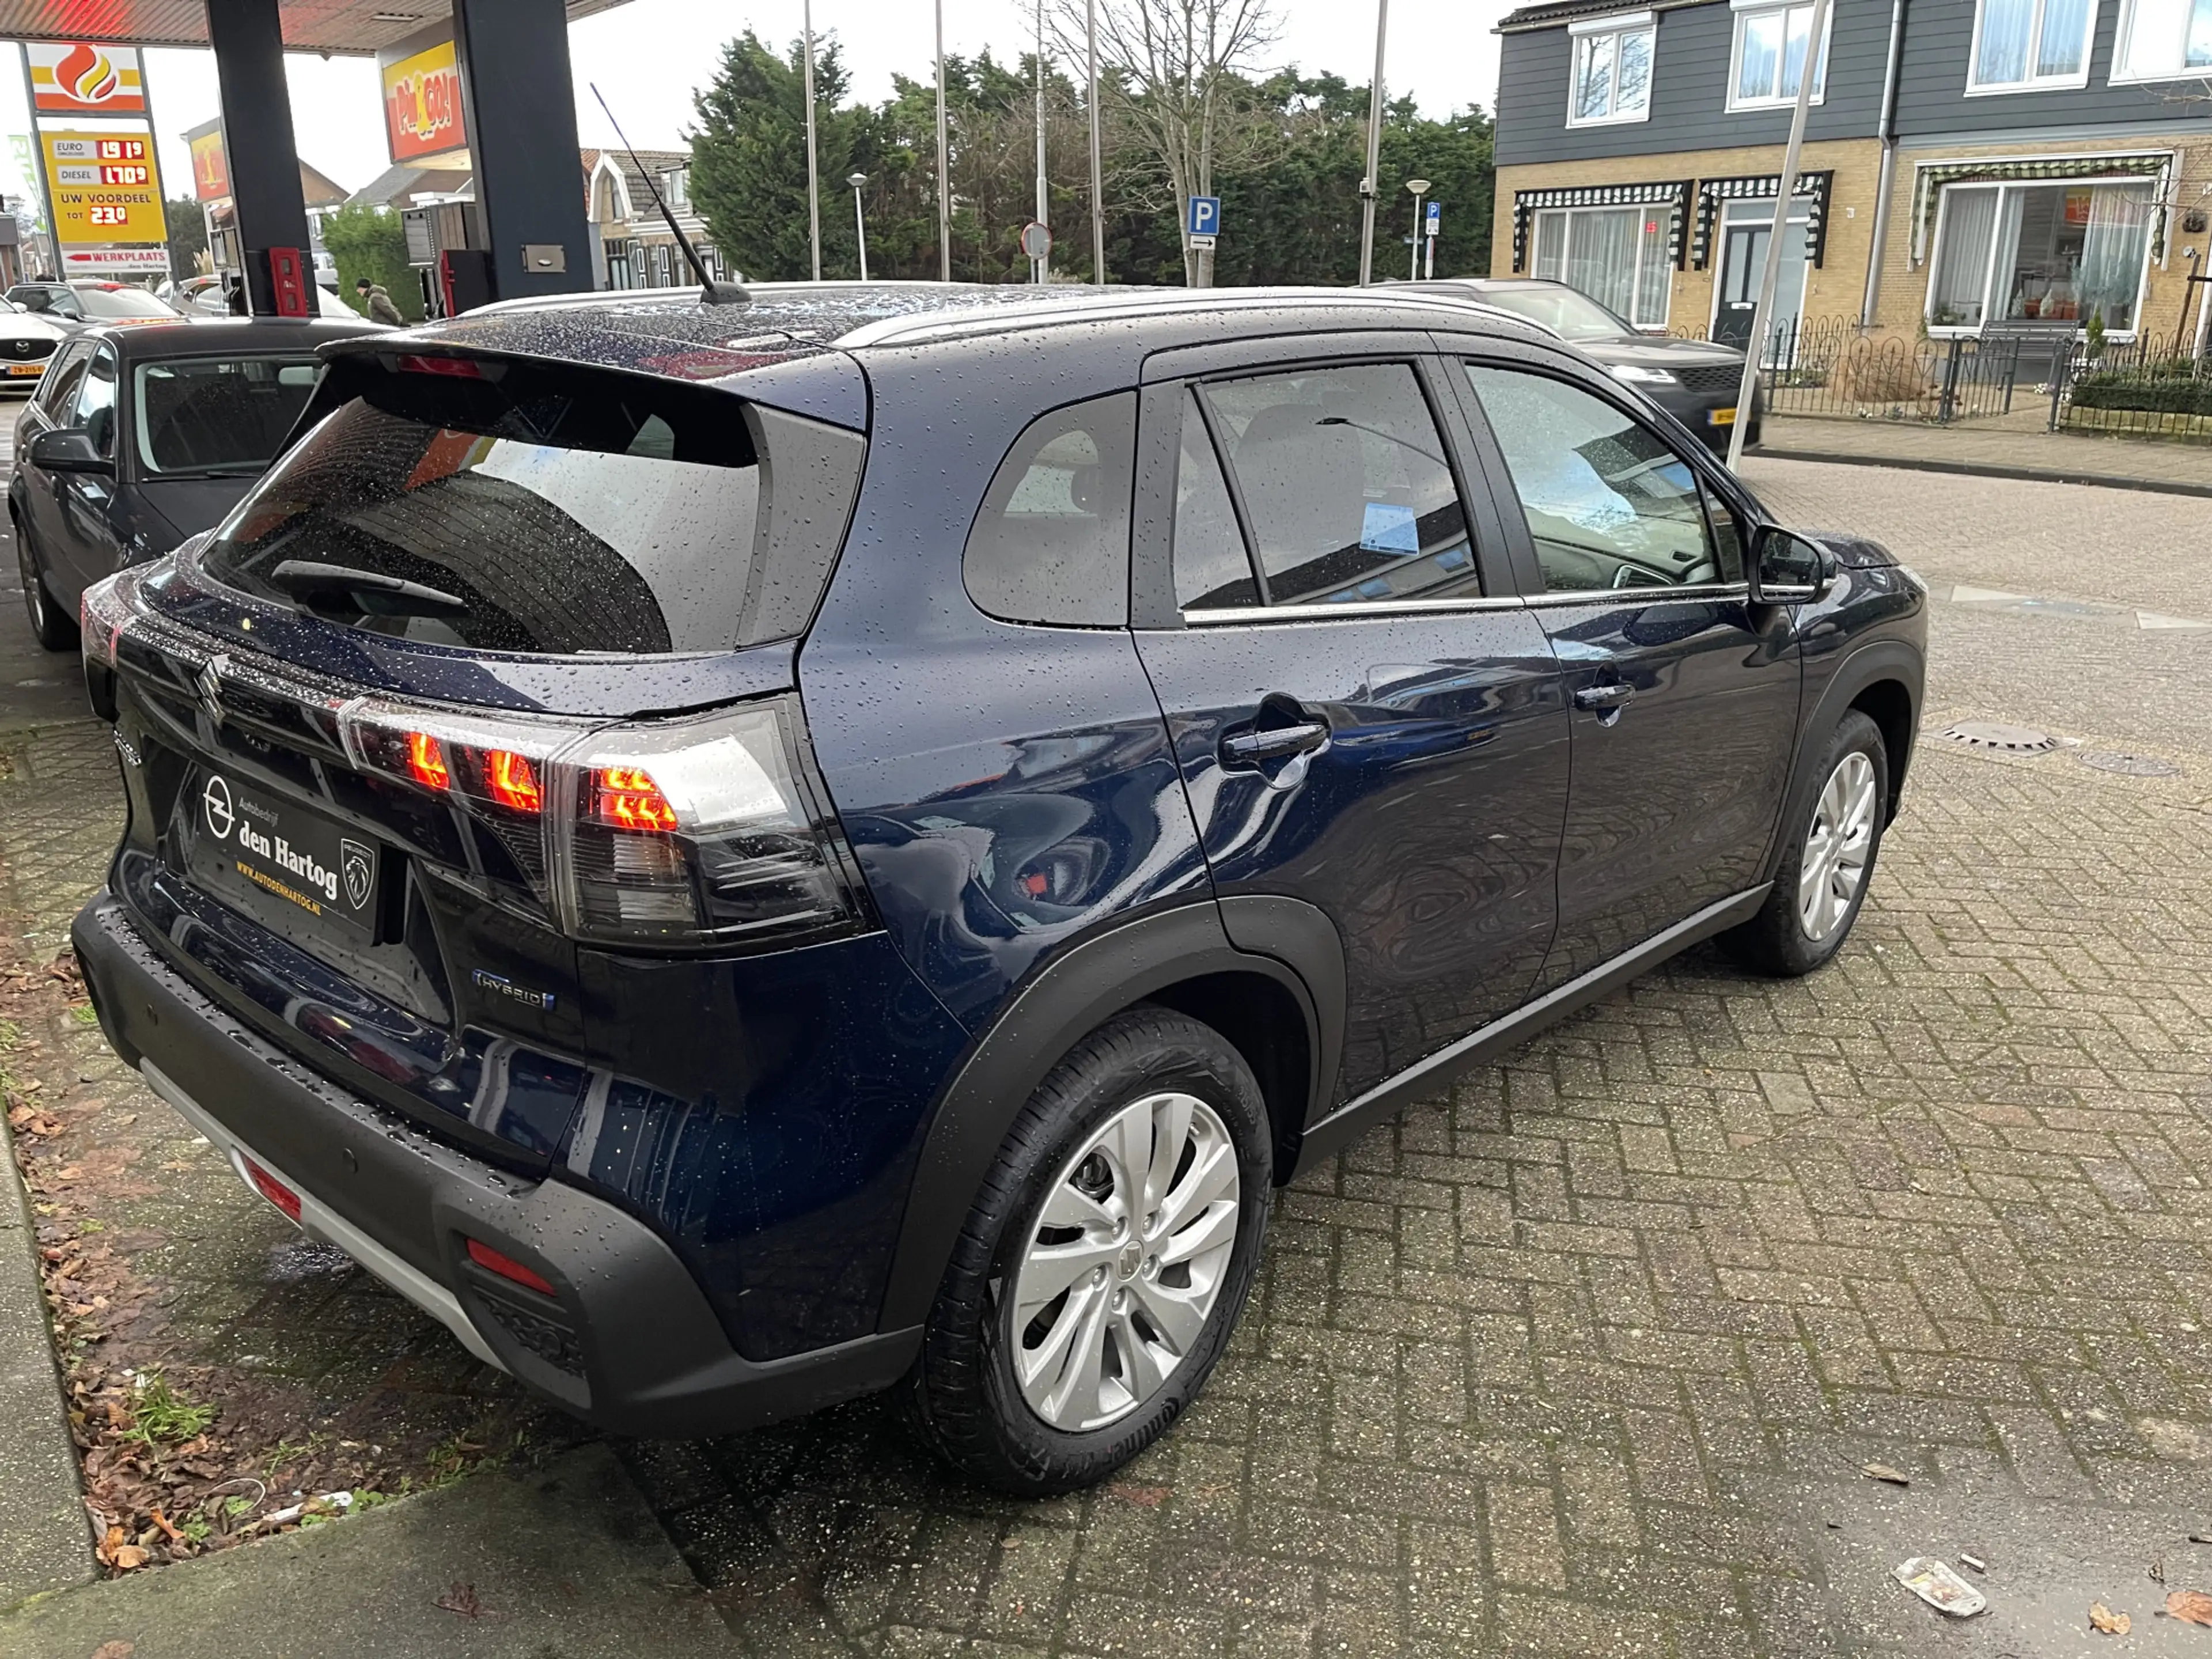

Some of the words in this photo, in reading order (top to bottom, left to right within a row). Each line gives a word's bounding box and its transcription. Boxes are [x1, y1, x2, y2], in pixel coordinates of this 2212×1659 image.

[57, 142, 83, 151] EURO
[62, 171, 92, 179] DIESEL
[60, 194, 82, 203] UW
[88, 194, 151, 203] VOORDEEL
[1196, 202, 1213, 230] P
[1430, 204, 1438, 217] P
[92, 252, 166, 262] WERKPLAATS
[238, 797, 279, 827] Autobedrijf
[239, 821, 271, 858] den
[274, 836, 338, 900] Hartog
[237, 861, 321, 916] WWW.AUTODENHARTOG.NL
[483, 978, 540, 1004] HYBRID
